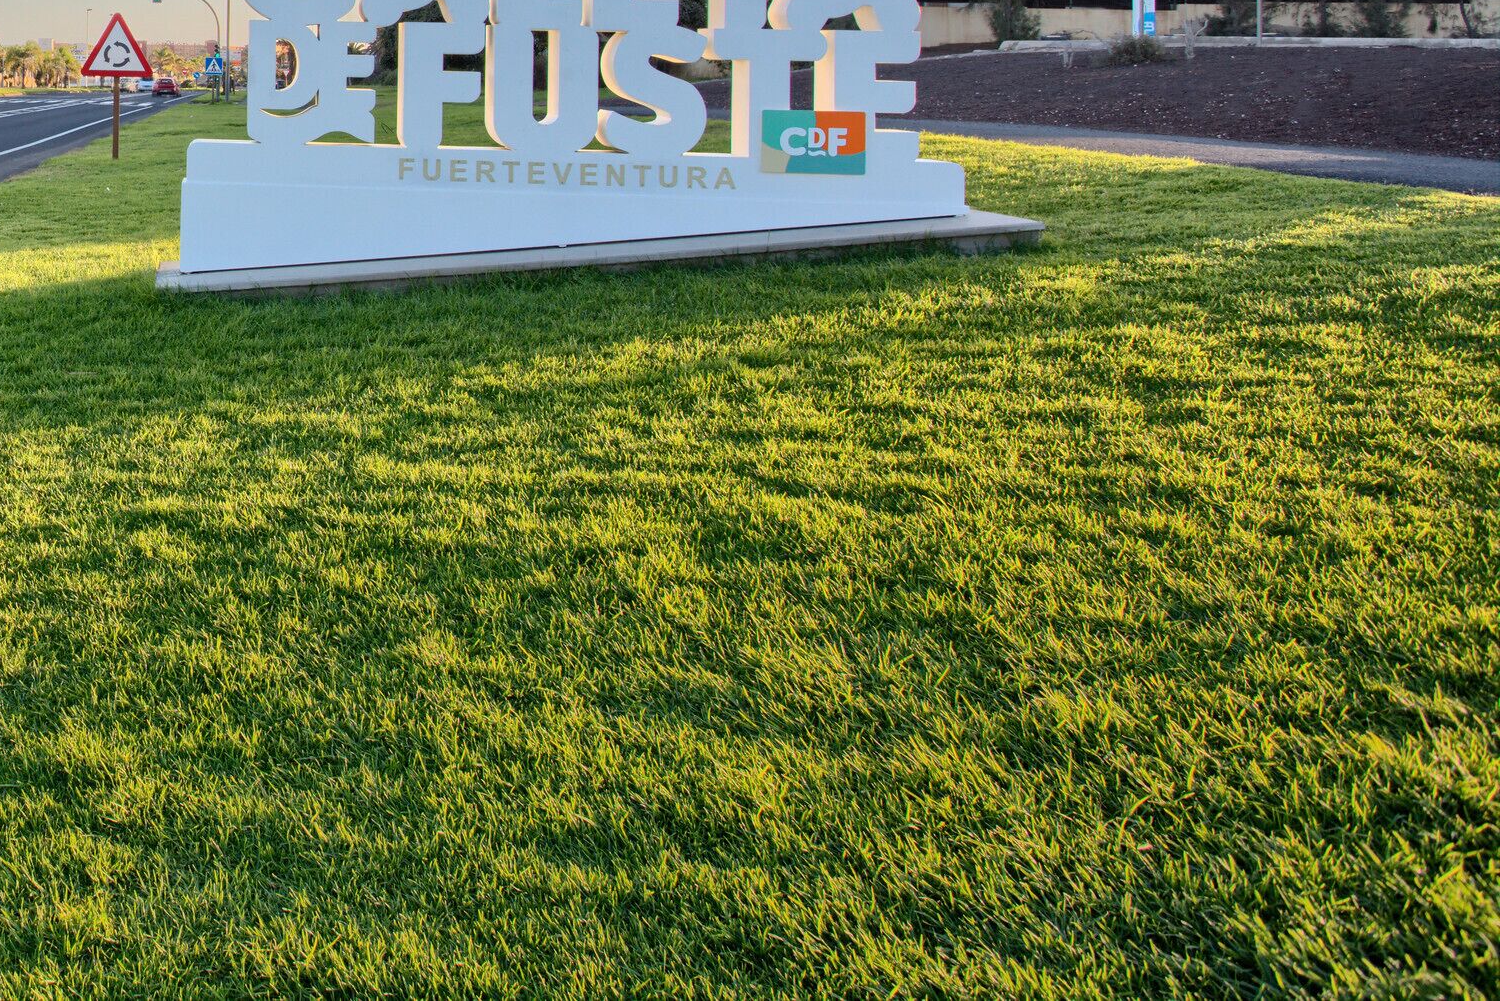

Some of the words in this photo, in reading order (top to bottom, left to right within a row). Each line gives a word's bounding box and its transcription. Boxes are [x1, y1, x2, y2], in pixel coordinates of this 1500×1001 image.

[247, 20, 377, 144] DE
[397, 22, 922, 159] FUSTE
[779, 126, 849, 158] CDF
[398, 157, 737, 190] FUERTEVENTURA
